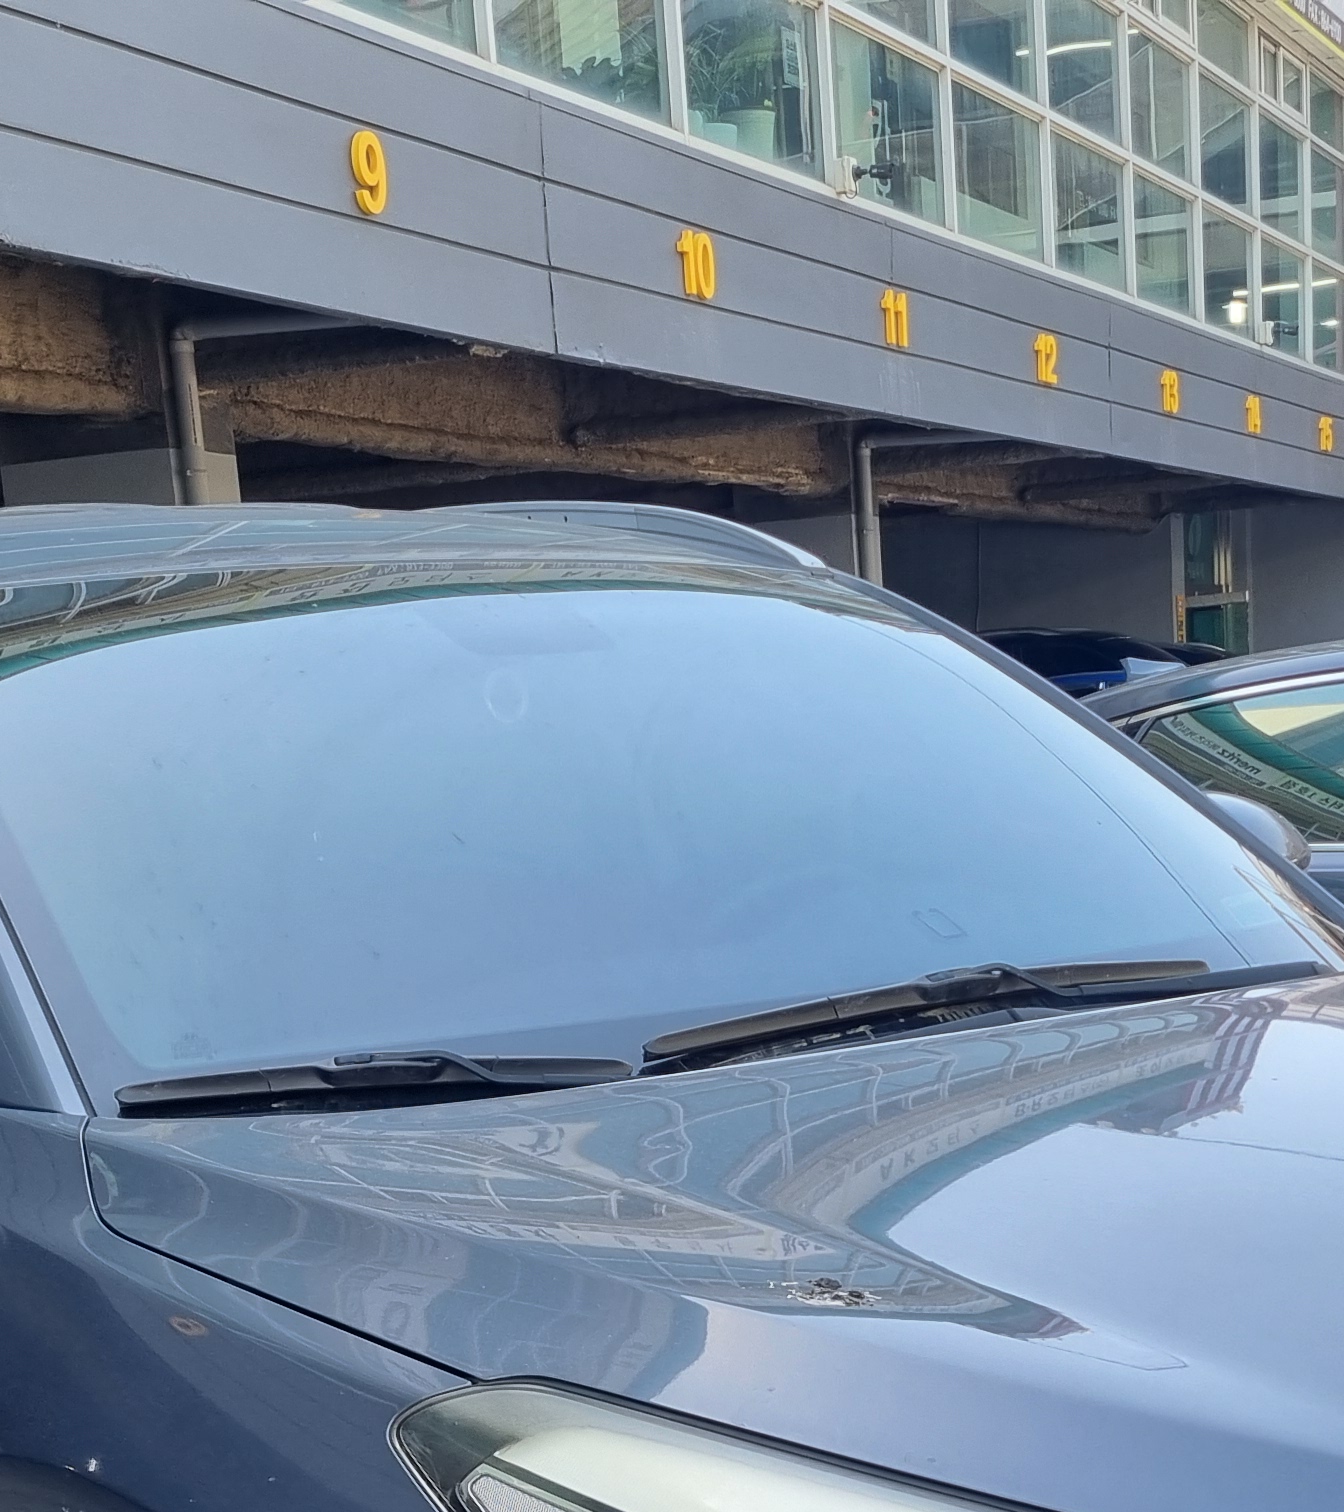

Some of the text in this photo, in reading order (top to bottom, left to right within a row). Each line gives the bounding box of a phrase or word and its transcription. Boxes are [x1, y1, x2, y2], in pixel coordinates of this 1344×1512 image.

[351, 130, 387, 216] 9
[676, 230, 715, 299] 10
[880, 289, 909, 348] 11
[1034, 333, 1058, 384] 12
[1160, 370, 1180, 414] 13
[1245, 394, 1261, 434] 14
[1318, 416, 1333, 452] 15
